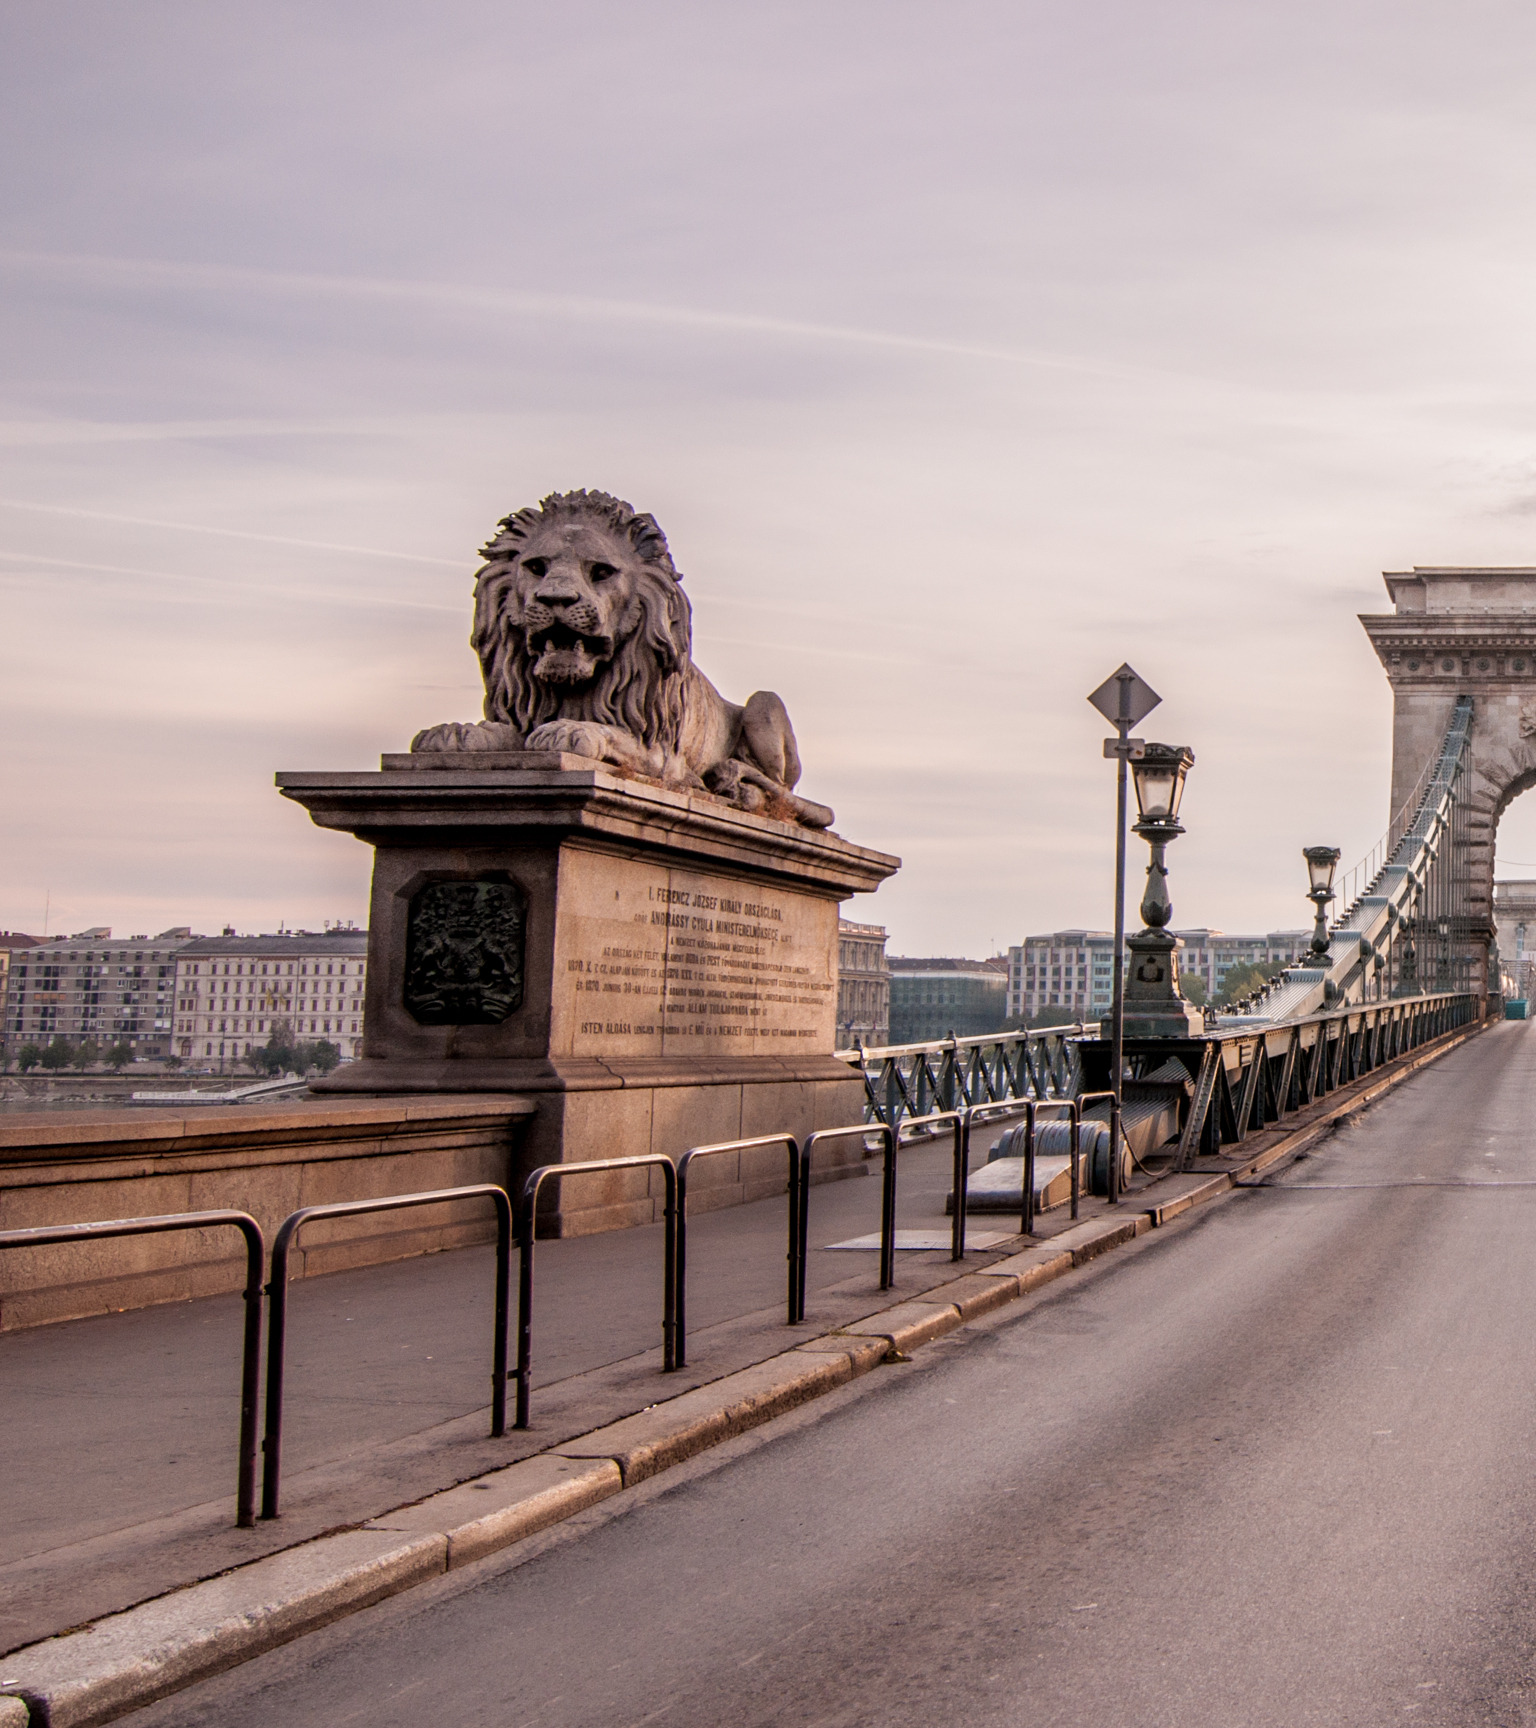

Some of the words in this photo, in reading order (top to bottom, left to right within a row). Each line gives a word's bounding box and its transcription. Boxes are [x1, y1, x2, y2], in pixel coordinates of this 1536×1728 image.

[656, 888, 690, 906] FERENCZ
[692, 890, 718, 910] JÓZSEF
[720, 897, 742, 915] KIRÁLY
[650, 908, 690, 928] ANDRÁSSY
[581, 1021, 603, 1034] ISTEN
[605, 1018, 632, 1035] ÁLDÁSA
[718, 1025, 743, 1037] NEMZET
